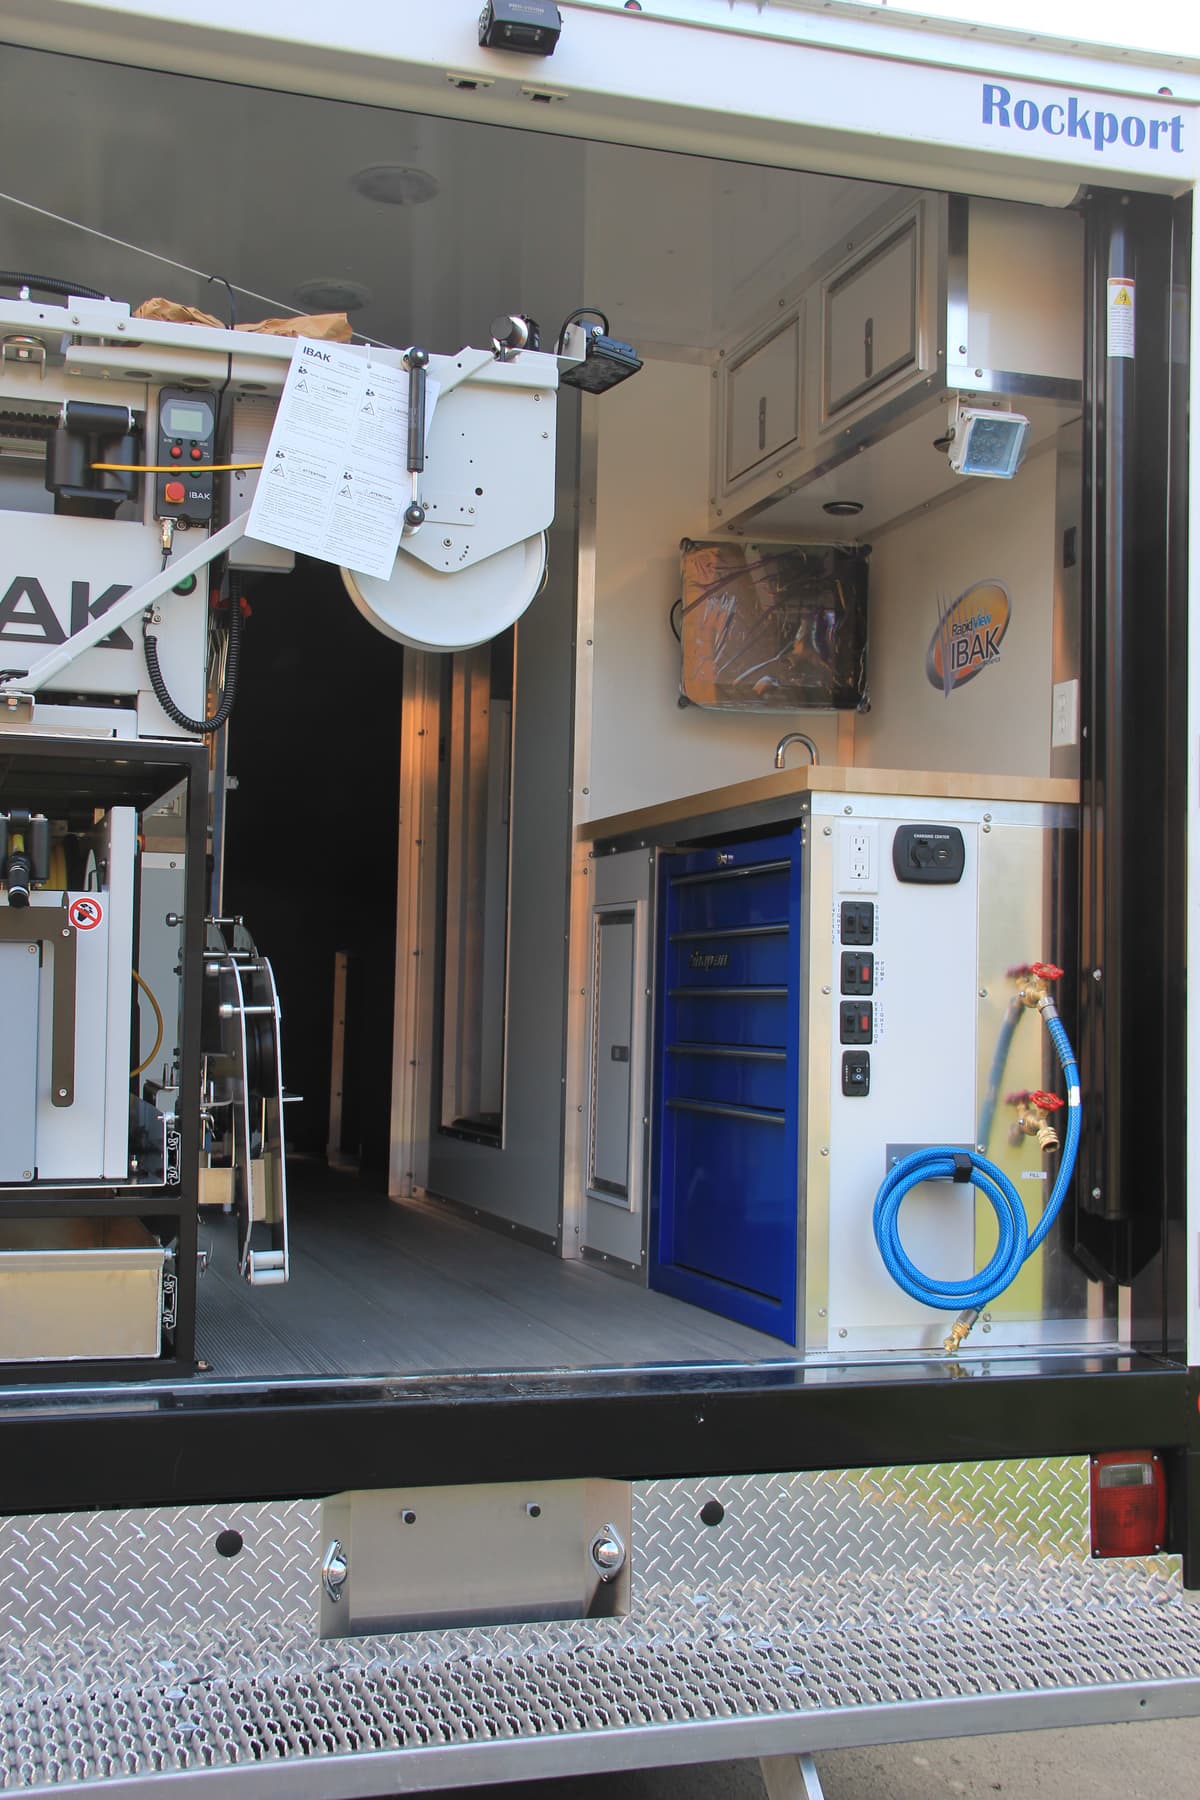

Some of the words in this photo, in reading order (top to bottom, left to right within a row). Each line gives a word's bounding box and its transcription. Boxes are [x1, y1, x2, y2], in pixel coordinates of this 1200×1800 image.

[982, 83, 1185, 153] Rockport
[303, 346, 331, 363] IBAK
[189, 491, 210, 500] IBAK
[951, 626, 1000, 670] IBAK
